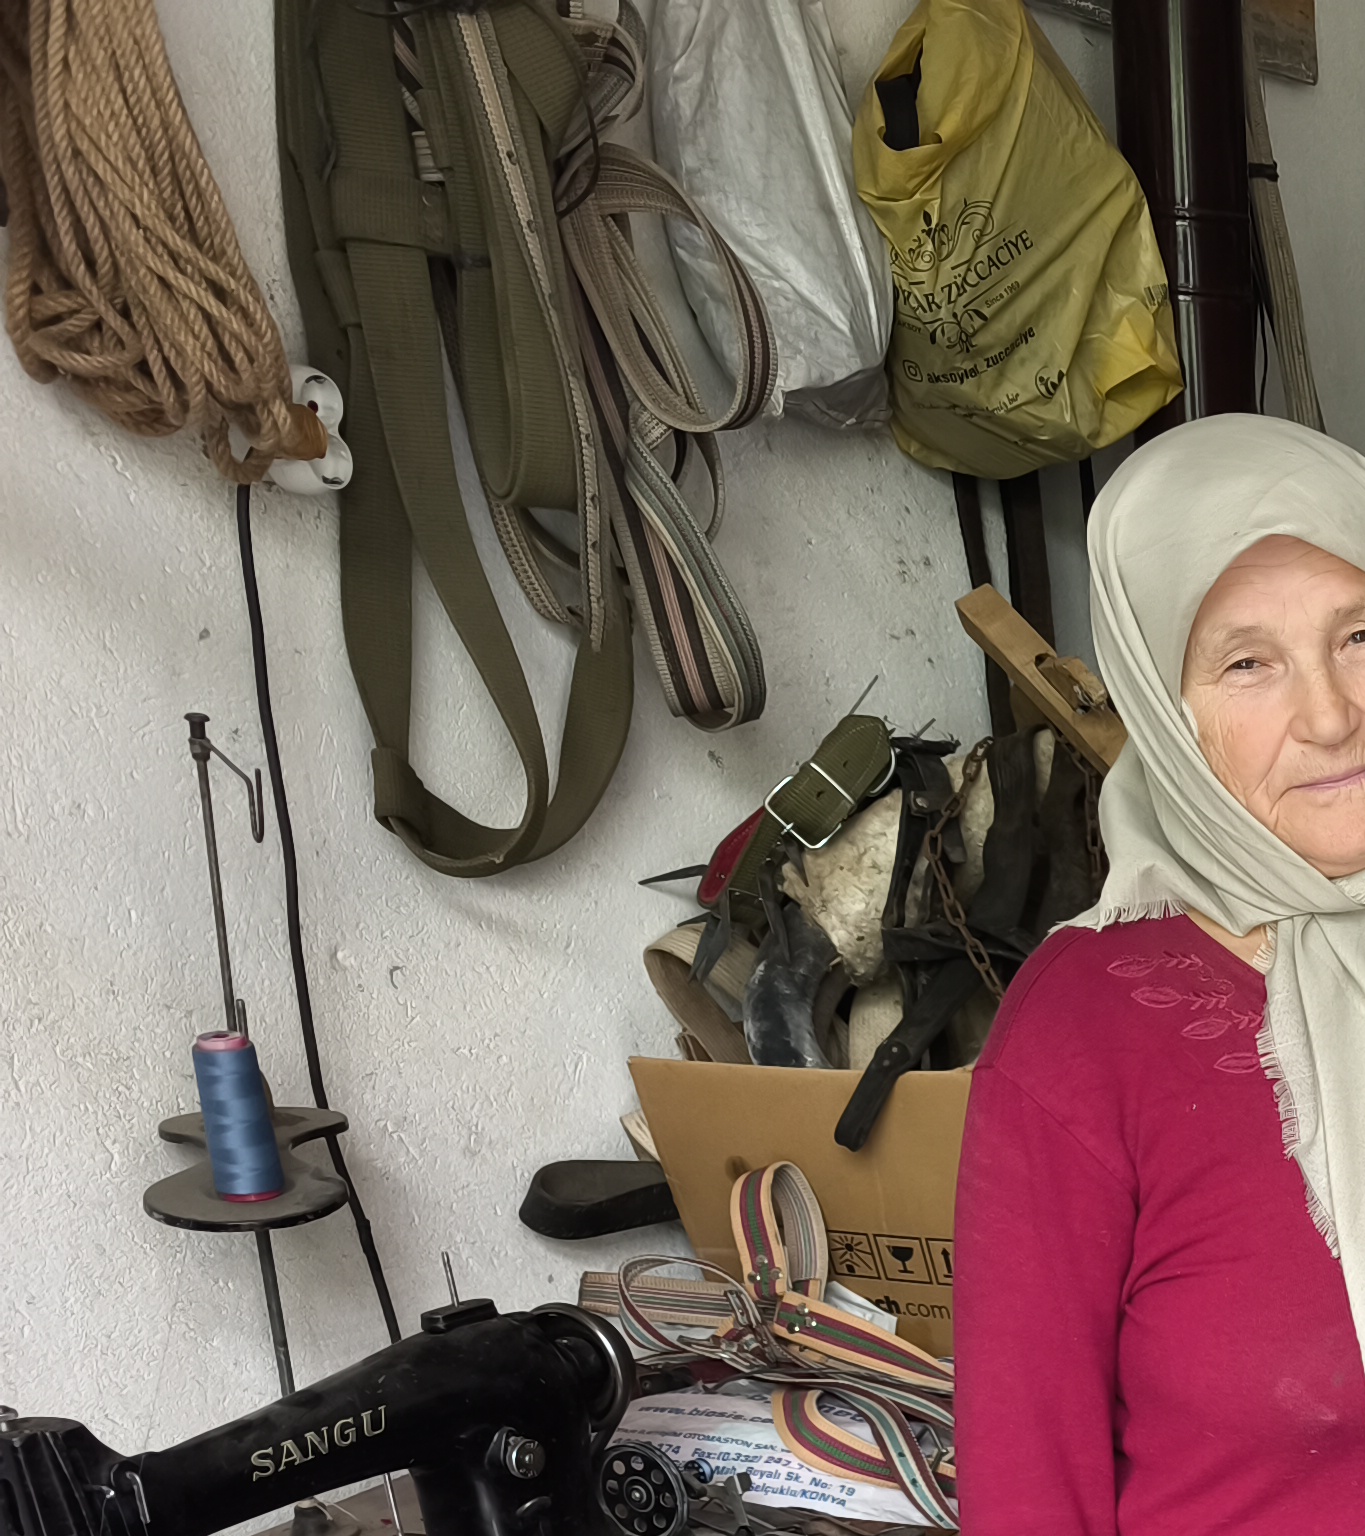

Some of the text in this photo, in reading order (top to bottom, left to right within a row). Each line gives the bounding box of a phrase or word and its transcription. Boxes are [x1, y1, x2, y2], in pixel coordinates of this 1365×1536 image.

[941, 229, 1034, 305] ZÜCCACİYE
[984, 292, 1004, 309] Since
[865, 1295, 951, 1320] ch.com
[250, 1404, 387, 1482] SANGU
[808, 1476, 834, 1491] No:
[838, 1483, 856, 1498] 19
